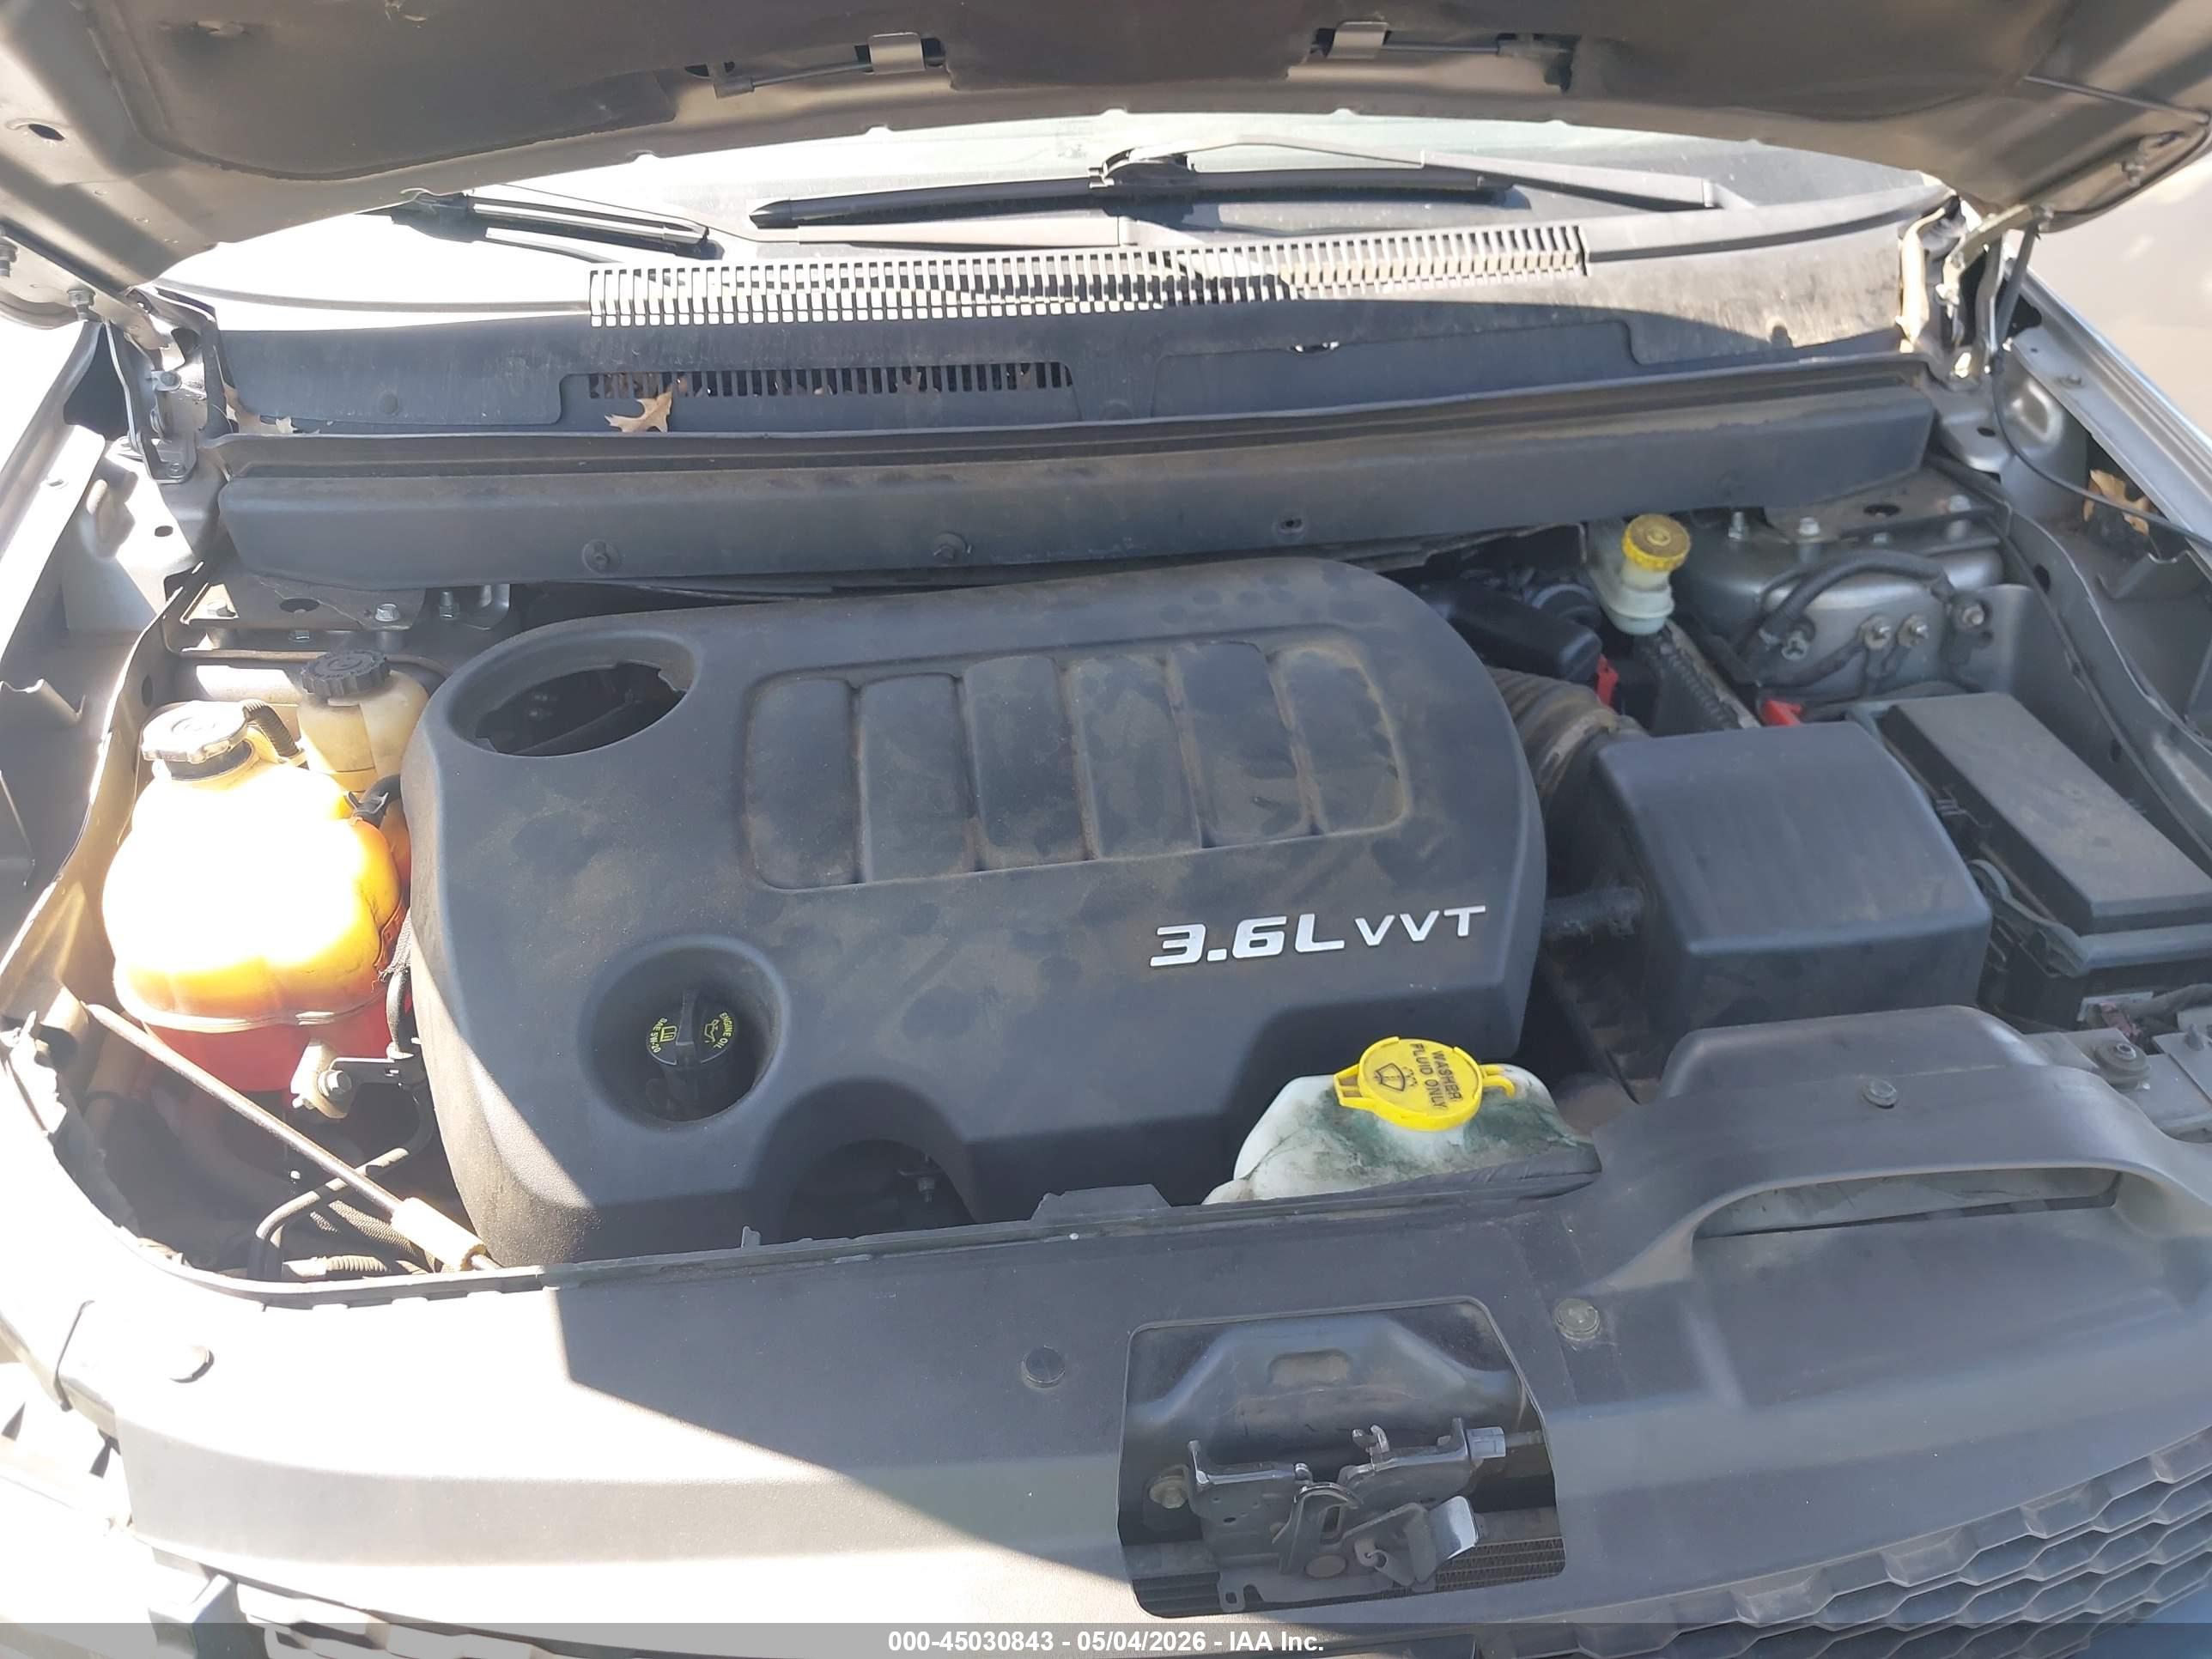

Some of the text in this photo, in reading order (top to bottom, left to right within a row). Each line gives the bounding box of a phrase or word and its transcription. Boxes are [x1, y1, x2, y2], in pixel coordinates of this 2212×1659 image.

[1149, 905, 1486, 968] 3.6L VVT
[649, 1018, 668, 1054] SAE 5W-20
[714, 1012, 733, 1049] ENGINE OIL
[1409, 1043, 1448, 1109] FLUID ONLY
[1431, 1050, 1464, 1102] WASHER
